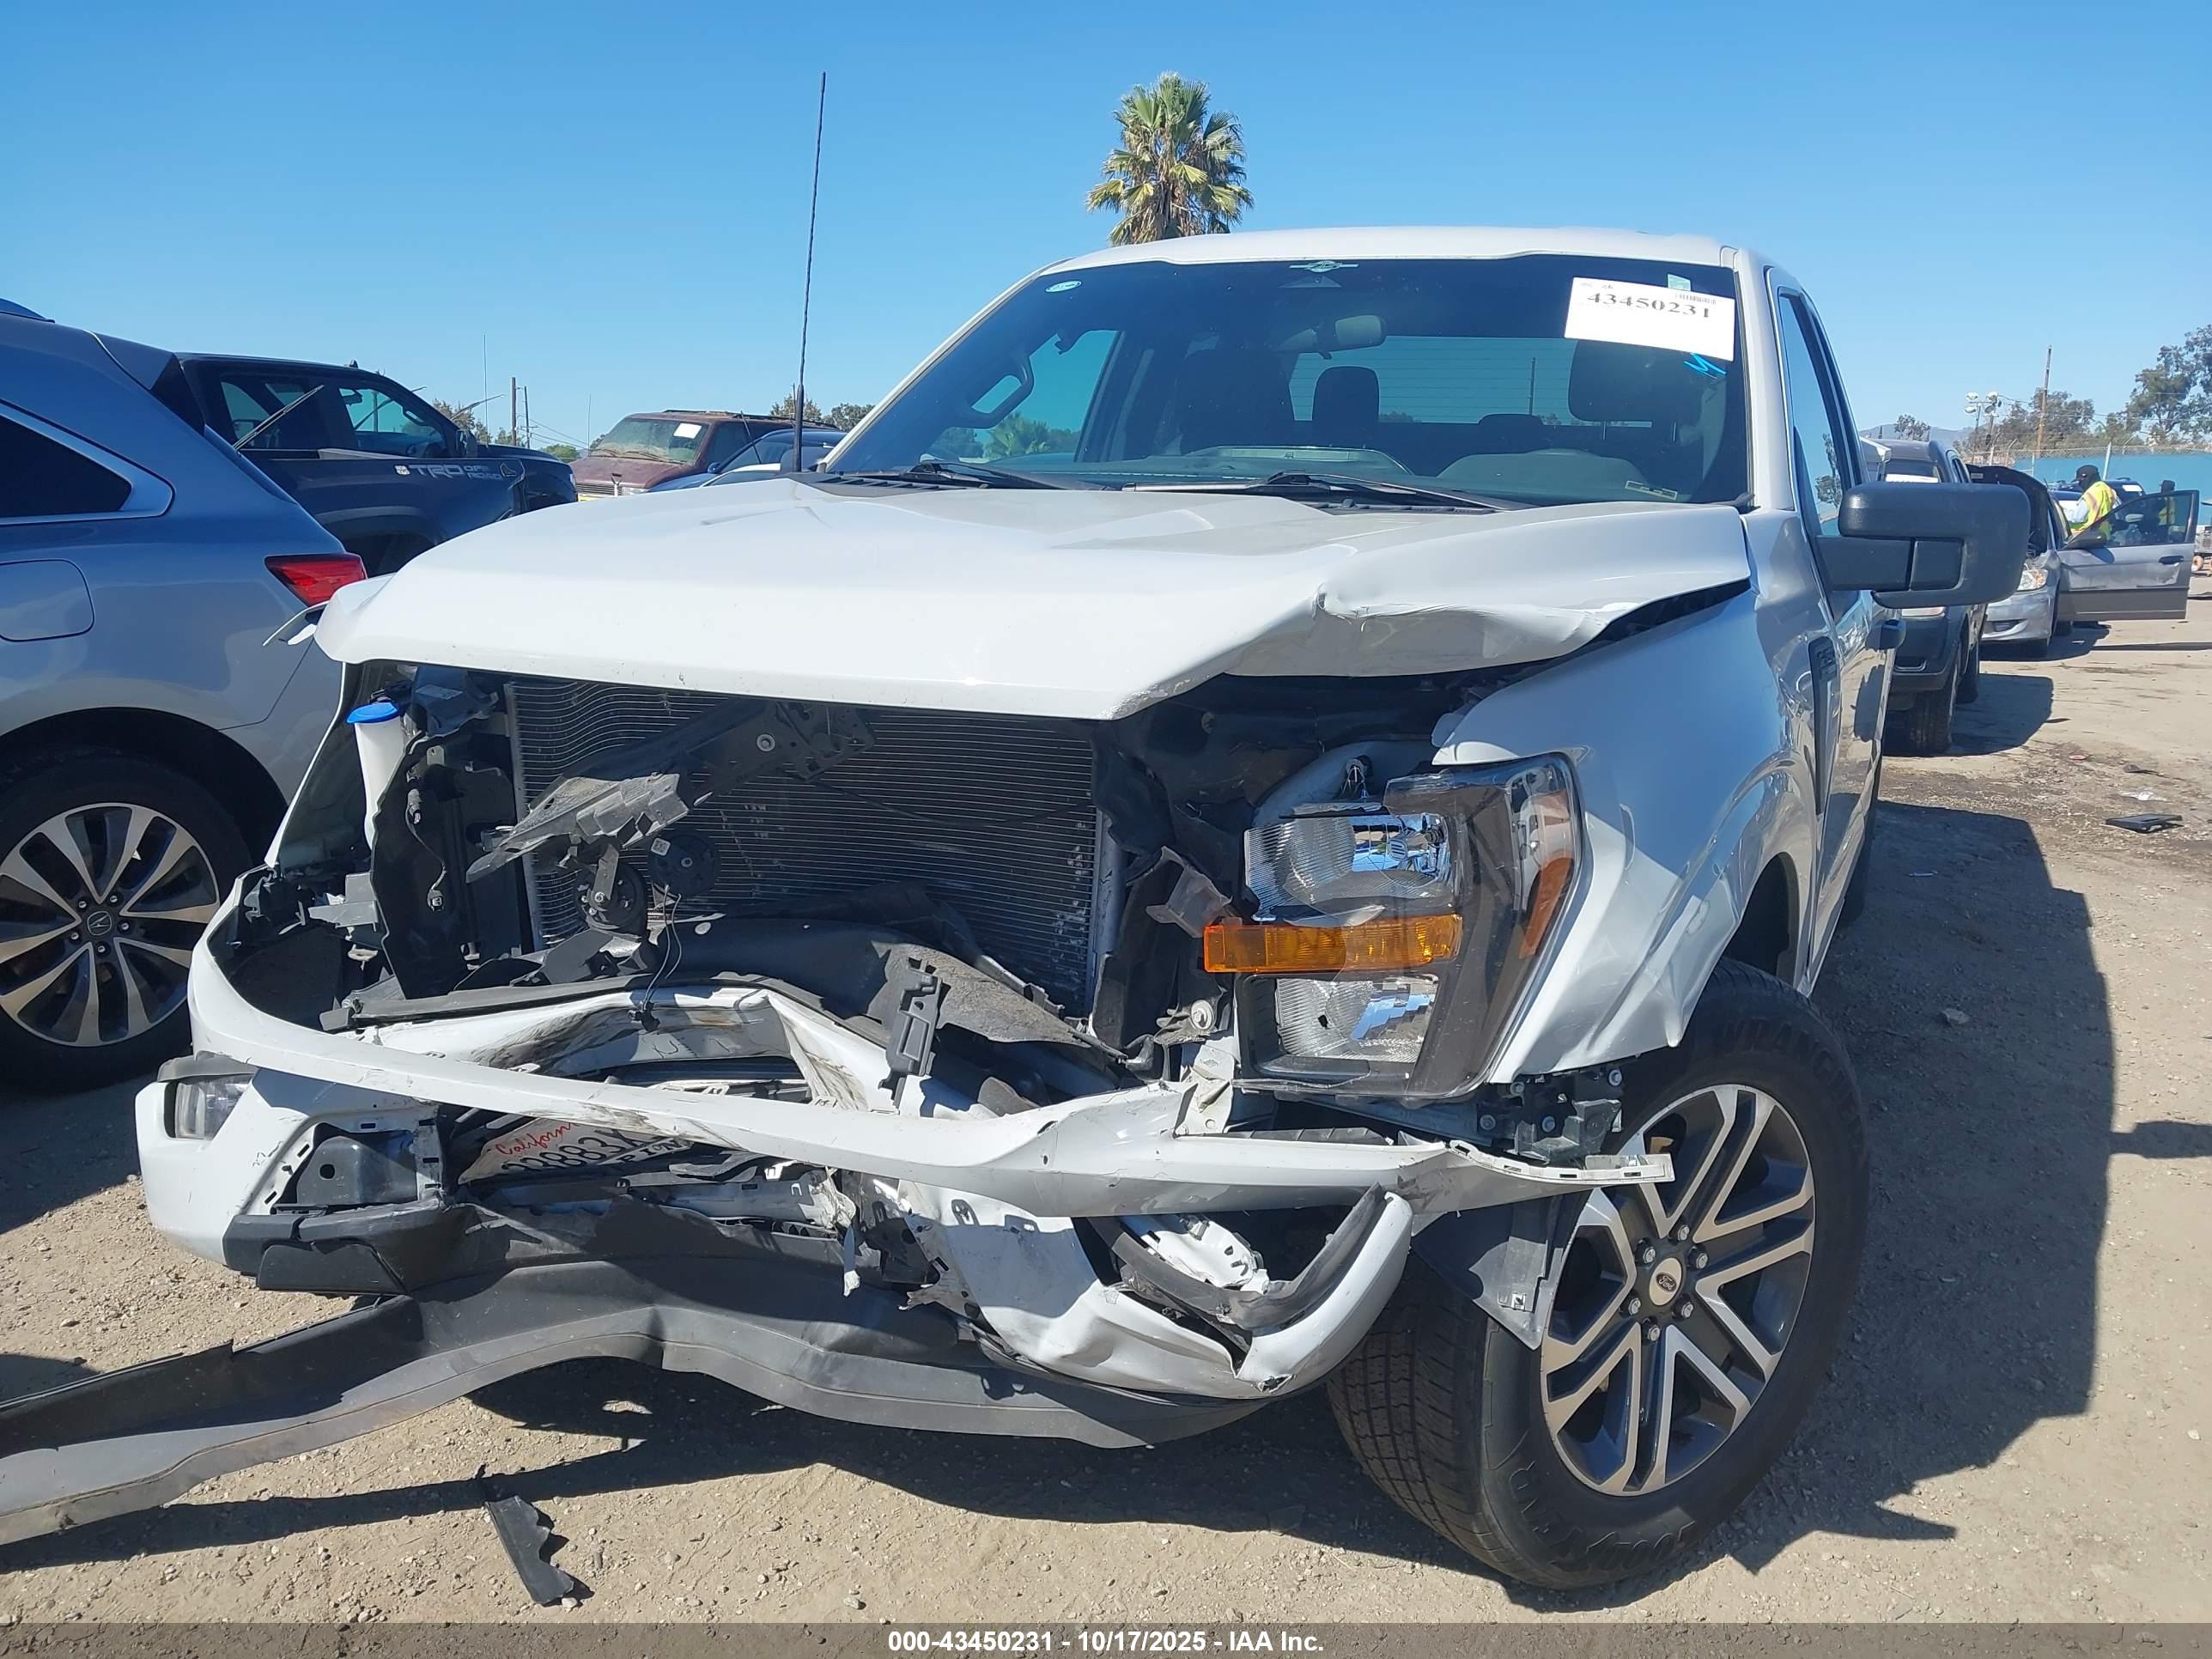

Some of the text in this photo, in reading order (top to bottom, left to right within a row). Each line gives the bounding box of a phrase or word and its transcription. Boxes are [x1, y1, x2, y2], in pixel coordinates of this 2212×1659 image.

[1587, 292, 1710, 318] 43450231
[409, 465, 464, 478] TRD
[1658, 1275, 1676, 1291] Ford
